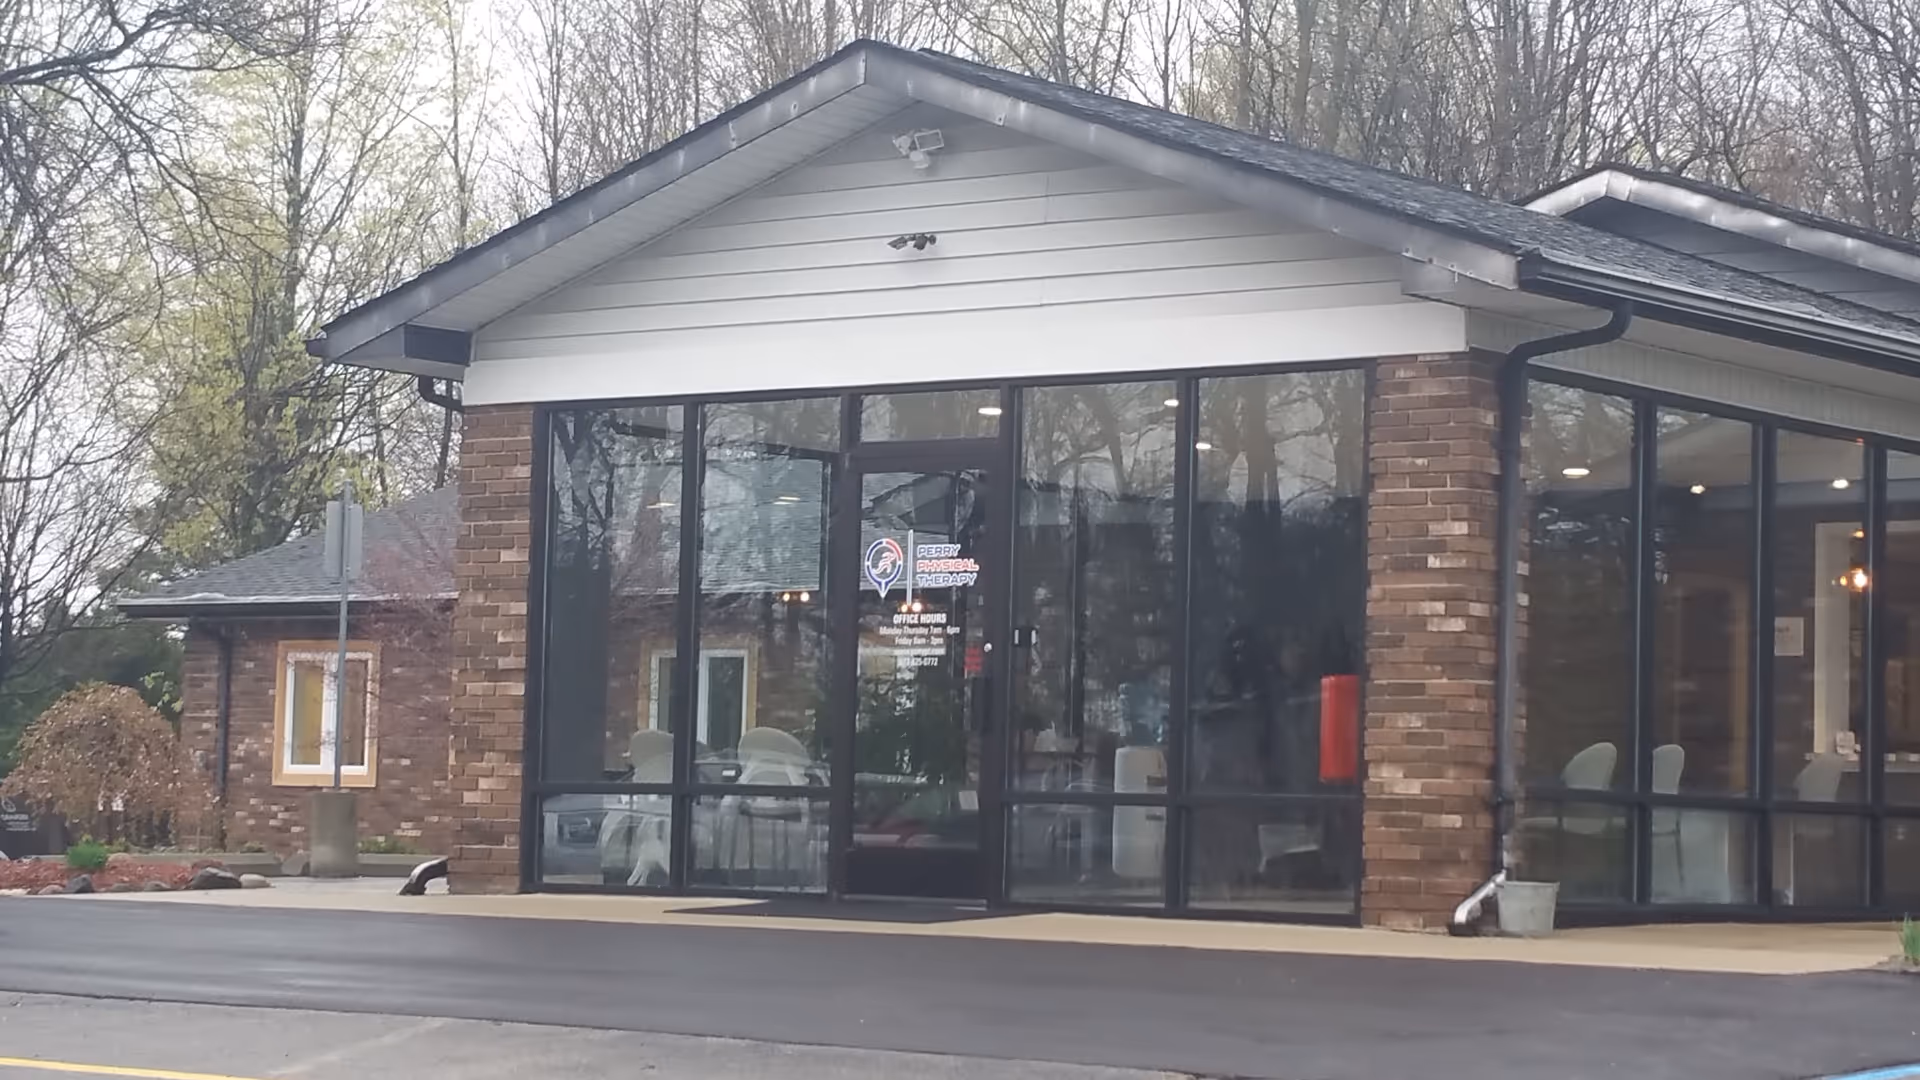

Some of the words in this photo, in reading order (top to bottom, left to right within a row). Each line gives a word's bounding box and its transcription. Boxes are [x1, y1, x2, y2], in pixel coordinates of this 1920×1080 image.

[917, 544, 961, 558] PERRY
[916, 558, 979, 573] PHYSICAL
[917, 573, 977, 587] THERAPY
[893, 614, 919, 625] OFFICE
[920, 613, 947, 624] HOURS
[895, 637, 912, 646] Friday
